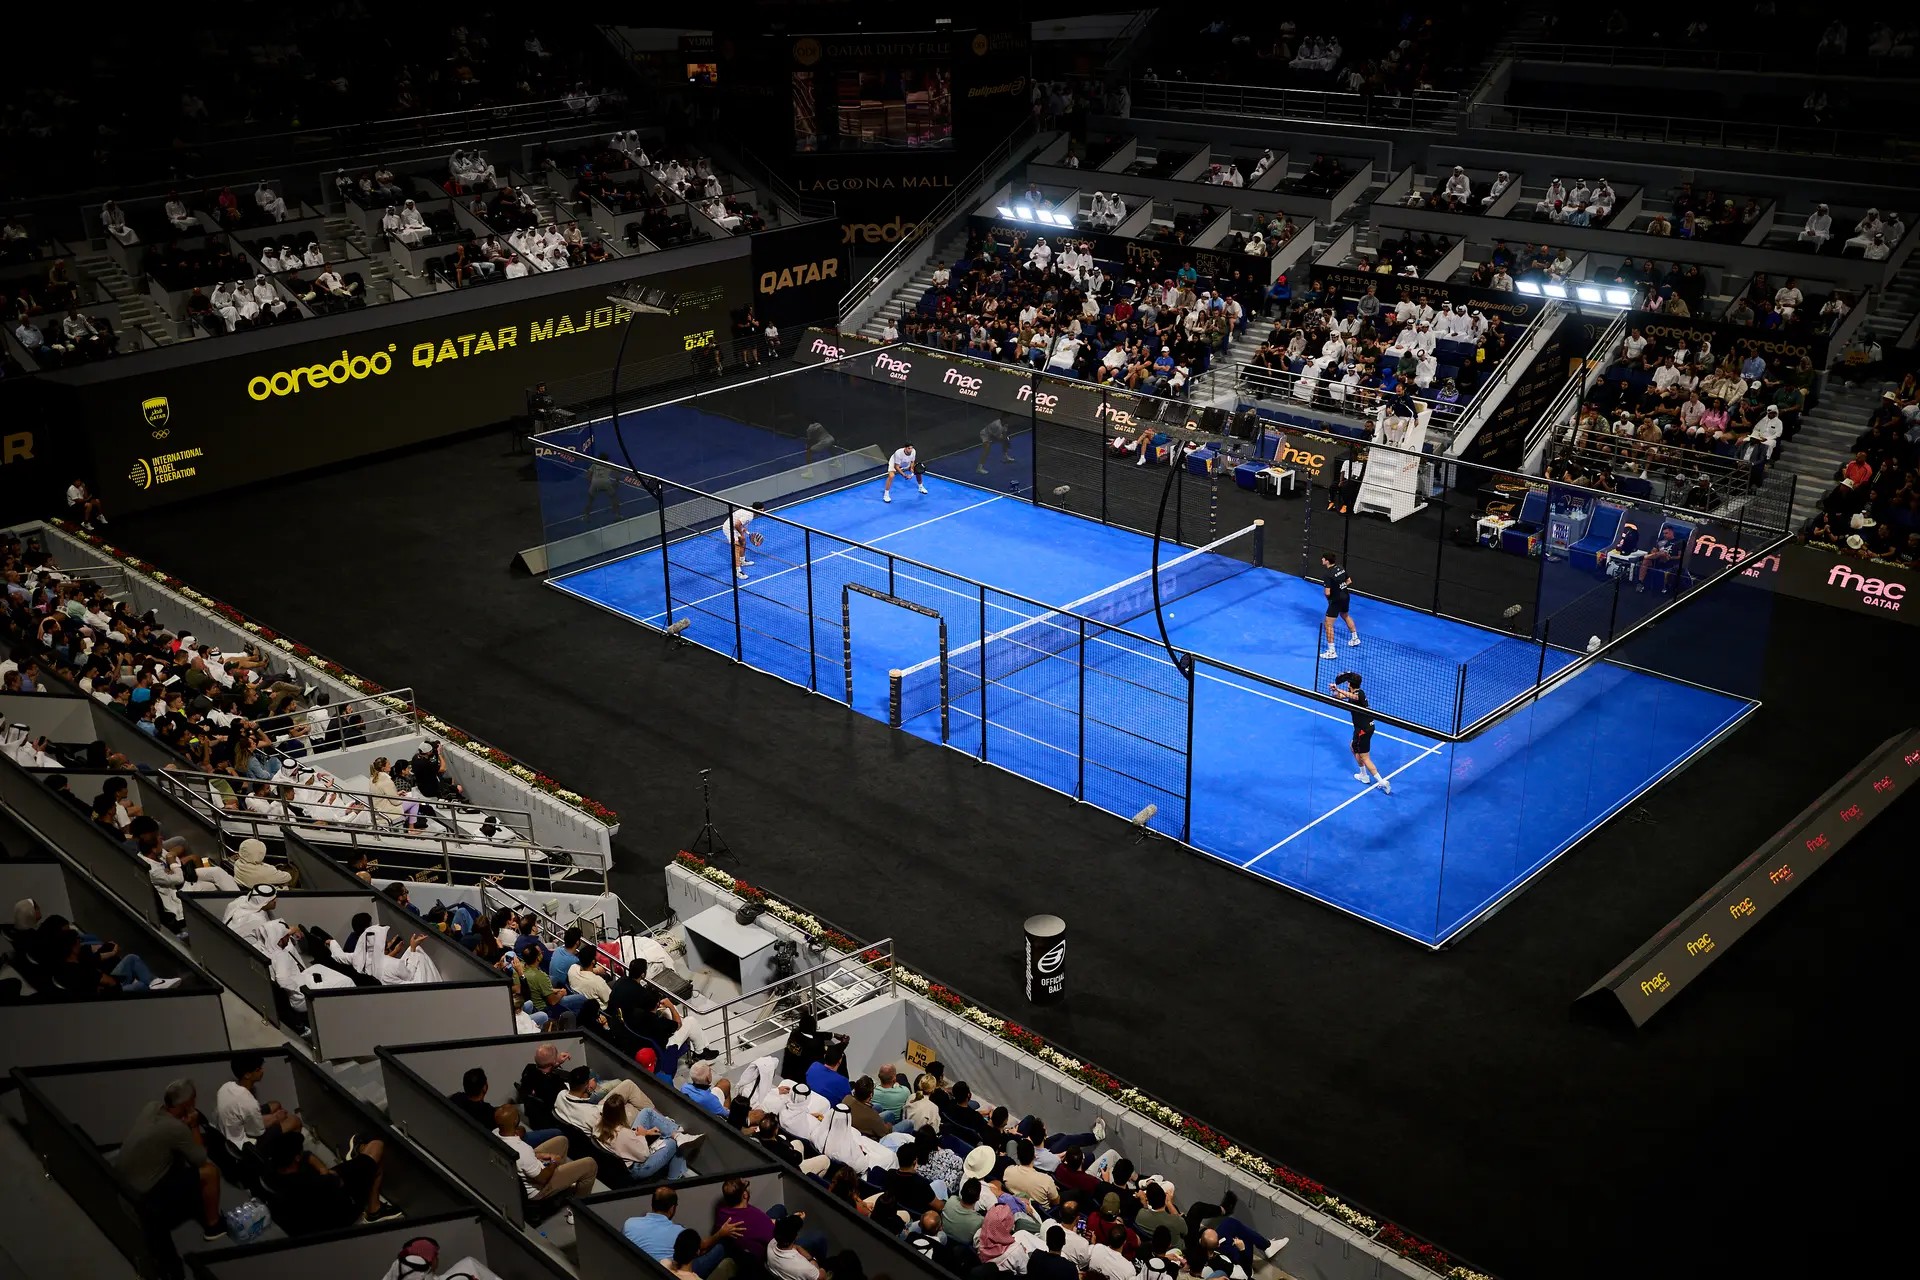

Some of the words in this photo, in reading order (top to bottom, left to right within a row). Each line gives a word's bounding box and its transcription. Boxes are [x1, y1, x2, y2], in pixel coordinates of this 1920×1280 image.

[799, 177, 895, 192] LAGOONA
[902, 175, 954, 188] MALL
[1126, 241, 1161, 259] fnac
[1196, 252, 1221, 262] FIFTY
[1196, 259, 1216, 268] ONE
[760, 258, 838, 295] QATAR
[1396, 282, 1449, 299] ASPETAR
[1467, 299, 1513, 313] Bullpadel
[412, 325, 518, 368] QATAR
[530, 304, 633, 343] MAJOR
[1645, 324, 1713, 343] ooredoo
[810, 338, 846, 359] fnac
[875, 352, 912, 375] fnac
[247, 349, 393, 401] ooredoo
[889, 371, 908, 381] QATAR
[943, 368, 983, 391] fnac
[959, 387, 979, 398] QATAR
[149, 413, 167, 422] QATAR
[1094, 401, 1138, 427] fnac
[1113, 423, 1137, 434] QATAR
[152, 447, 204, 467] INTERNATIONAL
[153, 462, 176, 476] PADEL
[155, 466, 196, 485] FEDERATION
[1827, 564, 1907, 600] fnac
[1862, 595, 1901, 612] QATAR
[1839, 803, 1861, 823] fnac
[1805, 833, 1828, 853] fnac
[1769, 863, 1792, 885] fnac
[1729, 897, 1754, 920] fnac
[1685, 932, 1712, 957] fnac
[1041, 971, 1065, 987] OFFICIAL
[1048, 982, 1063, 994] BALL
[1640, 970, 1668, 997] fnac
[907, 1054, 928, 1069] FLAS
[915, 1051, 927, 1062] NO
